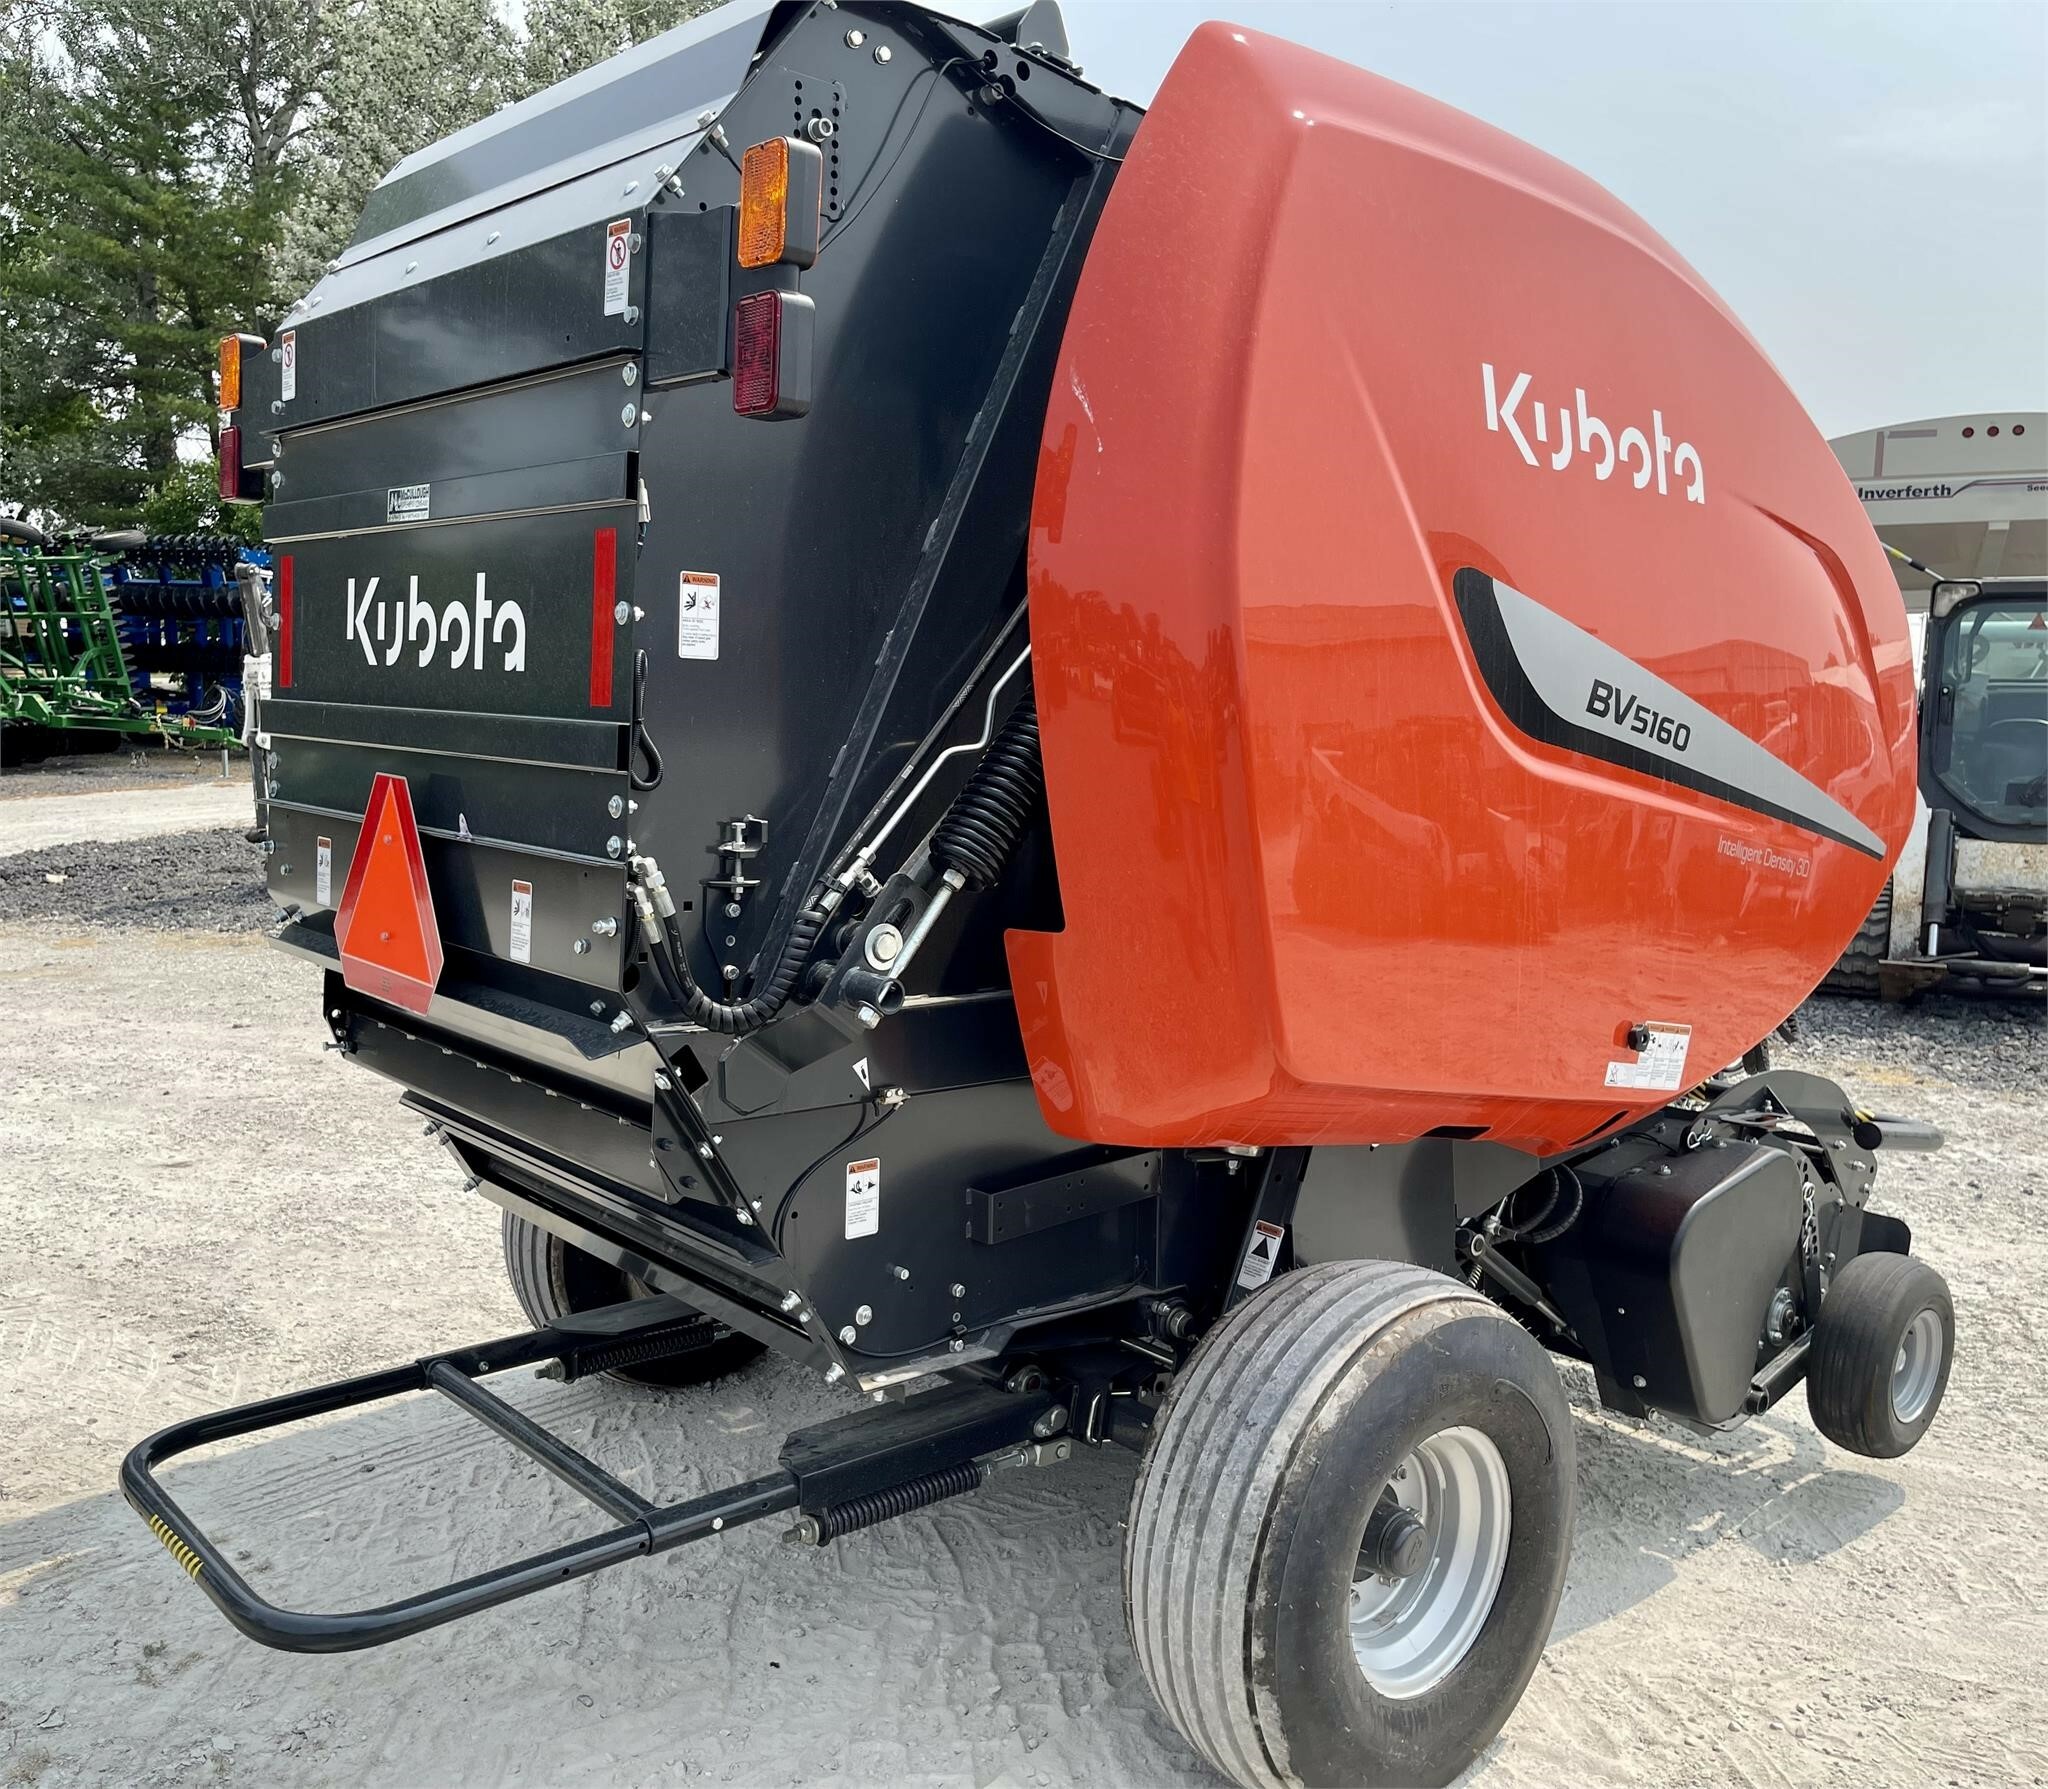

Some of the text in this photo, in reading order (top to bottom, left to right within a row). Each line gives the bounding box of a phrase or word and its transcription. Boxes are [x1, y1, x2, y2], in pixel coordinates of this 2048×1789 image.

[1482, 363, 1706, 505] Kubota
[346, 572, 526, 672] Kubota
[1585, 679, 1692, 753] BV5160
[1717, 834, 1810, 878] Intelligent Density 3D
